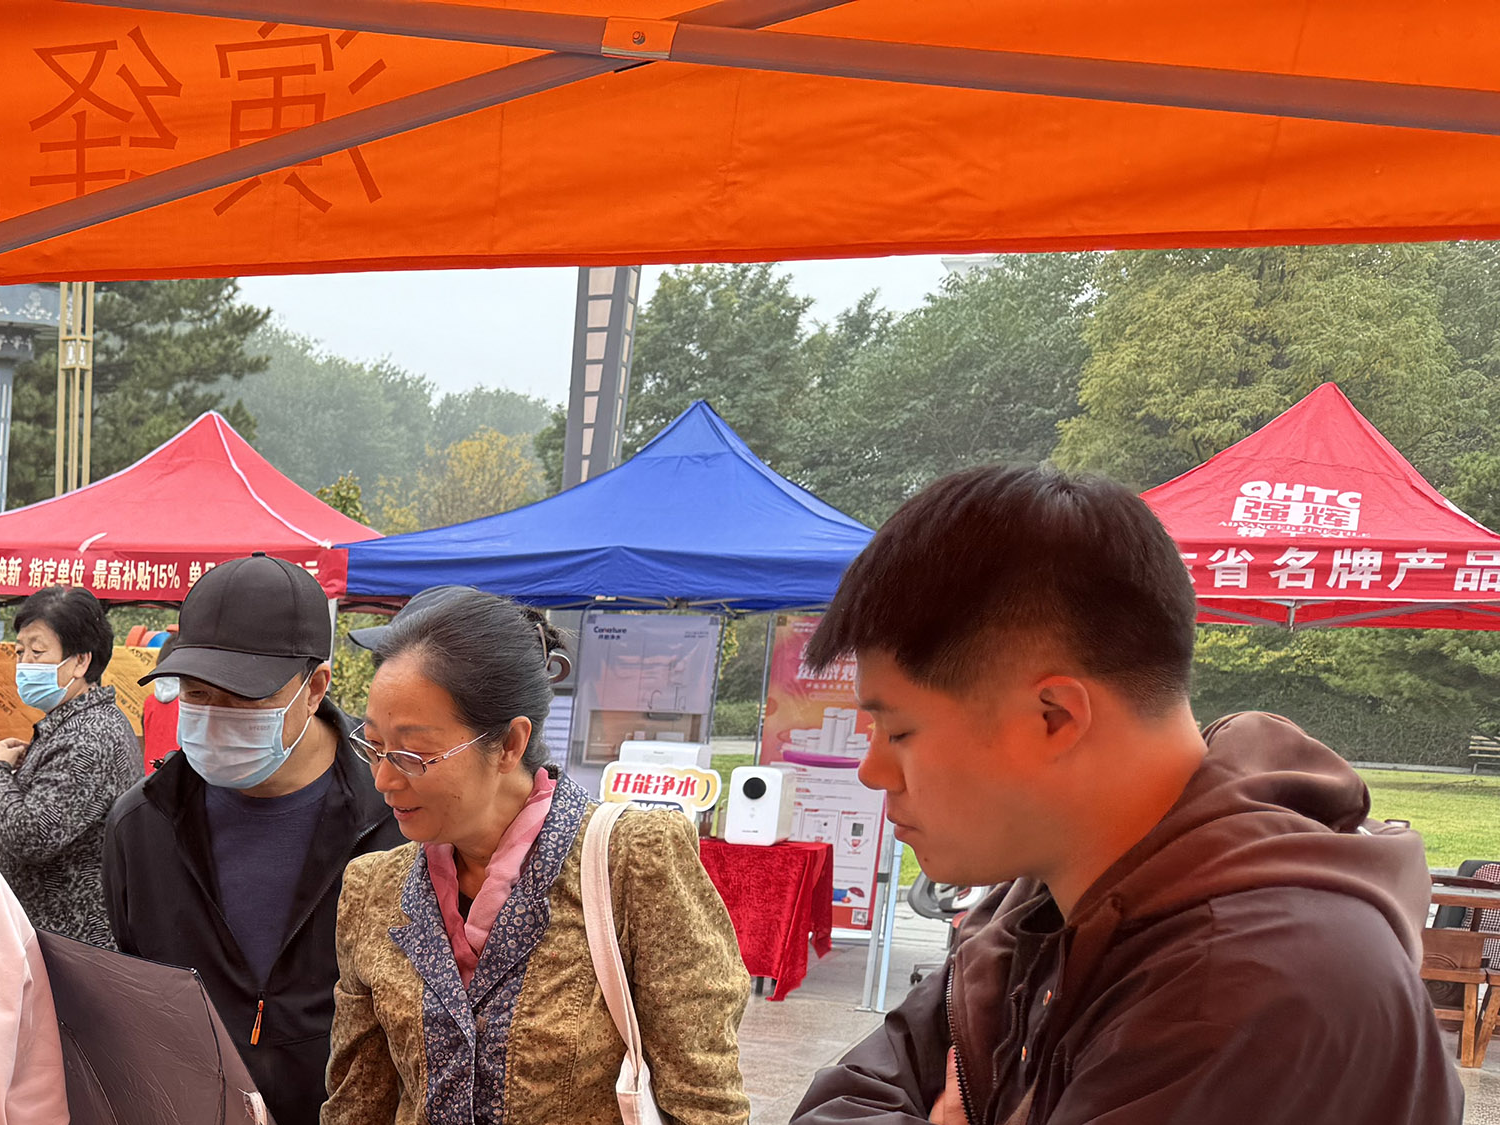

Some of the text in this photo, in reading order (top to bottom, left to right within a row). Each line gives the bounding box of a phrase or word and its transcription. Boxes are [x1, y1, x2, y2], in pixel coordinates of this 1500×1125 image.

[1240, 480, 1362, 509] QHTC
[28, 559, 84, 589] 指定单位
[92, 562, 180, 592] 最高补贴15%
[611, 771, 698, 797] 开能净水
